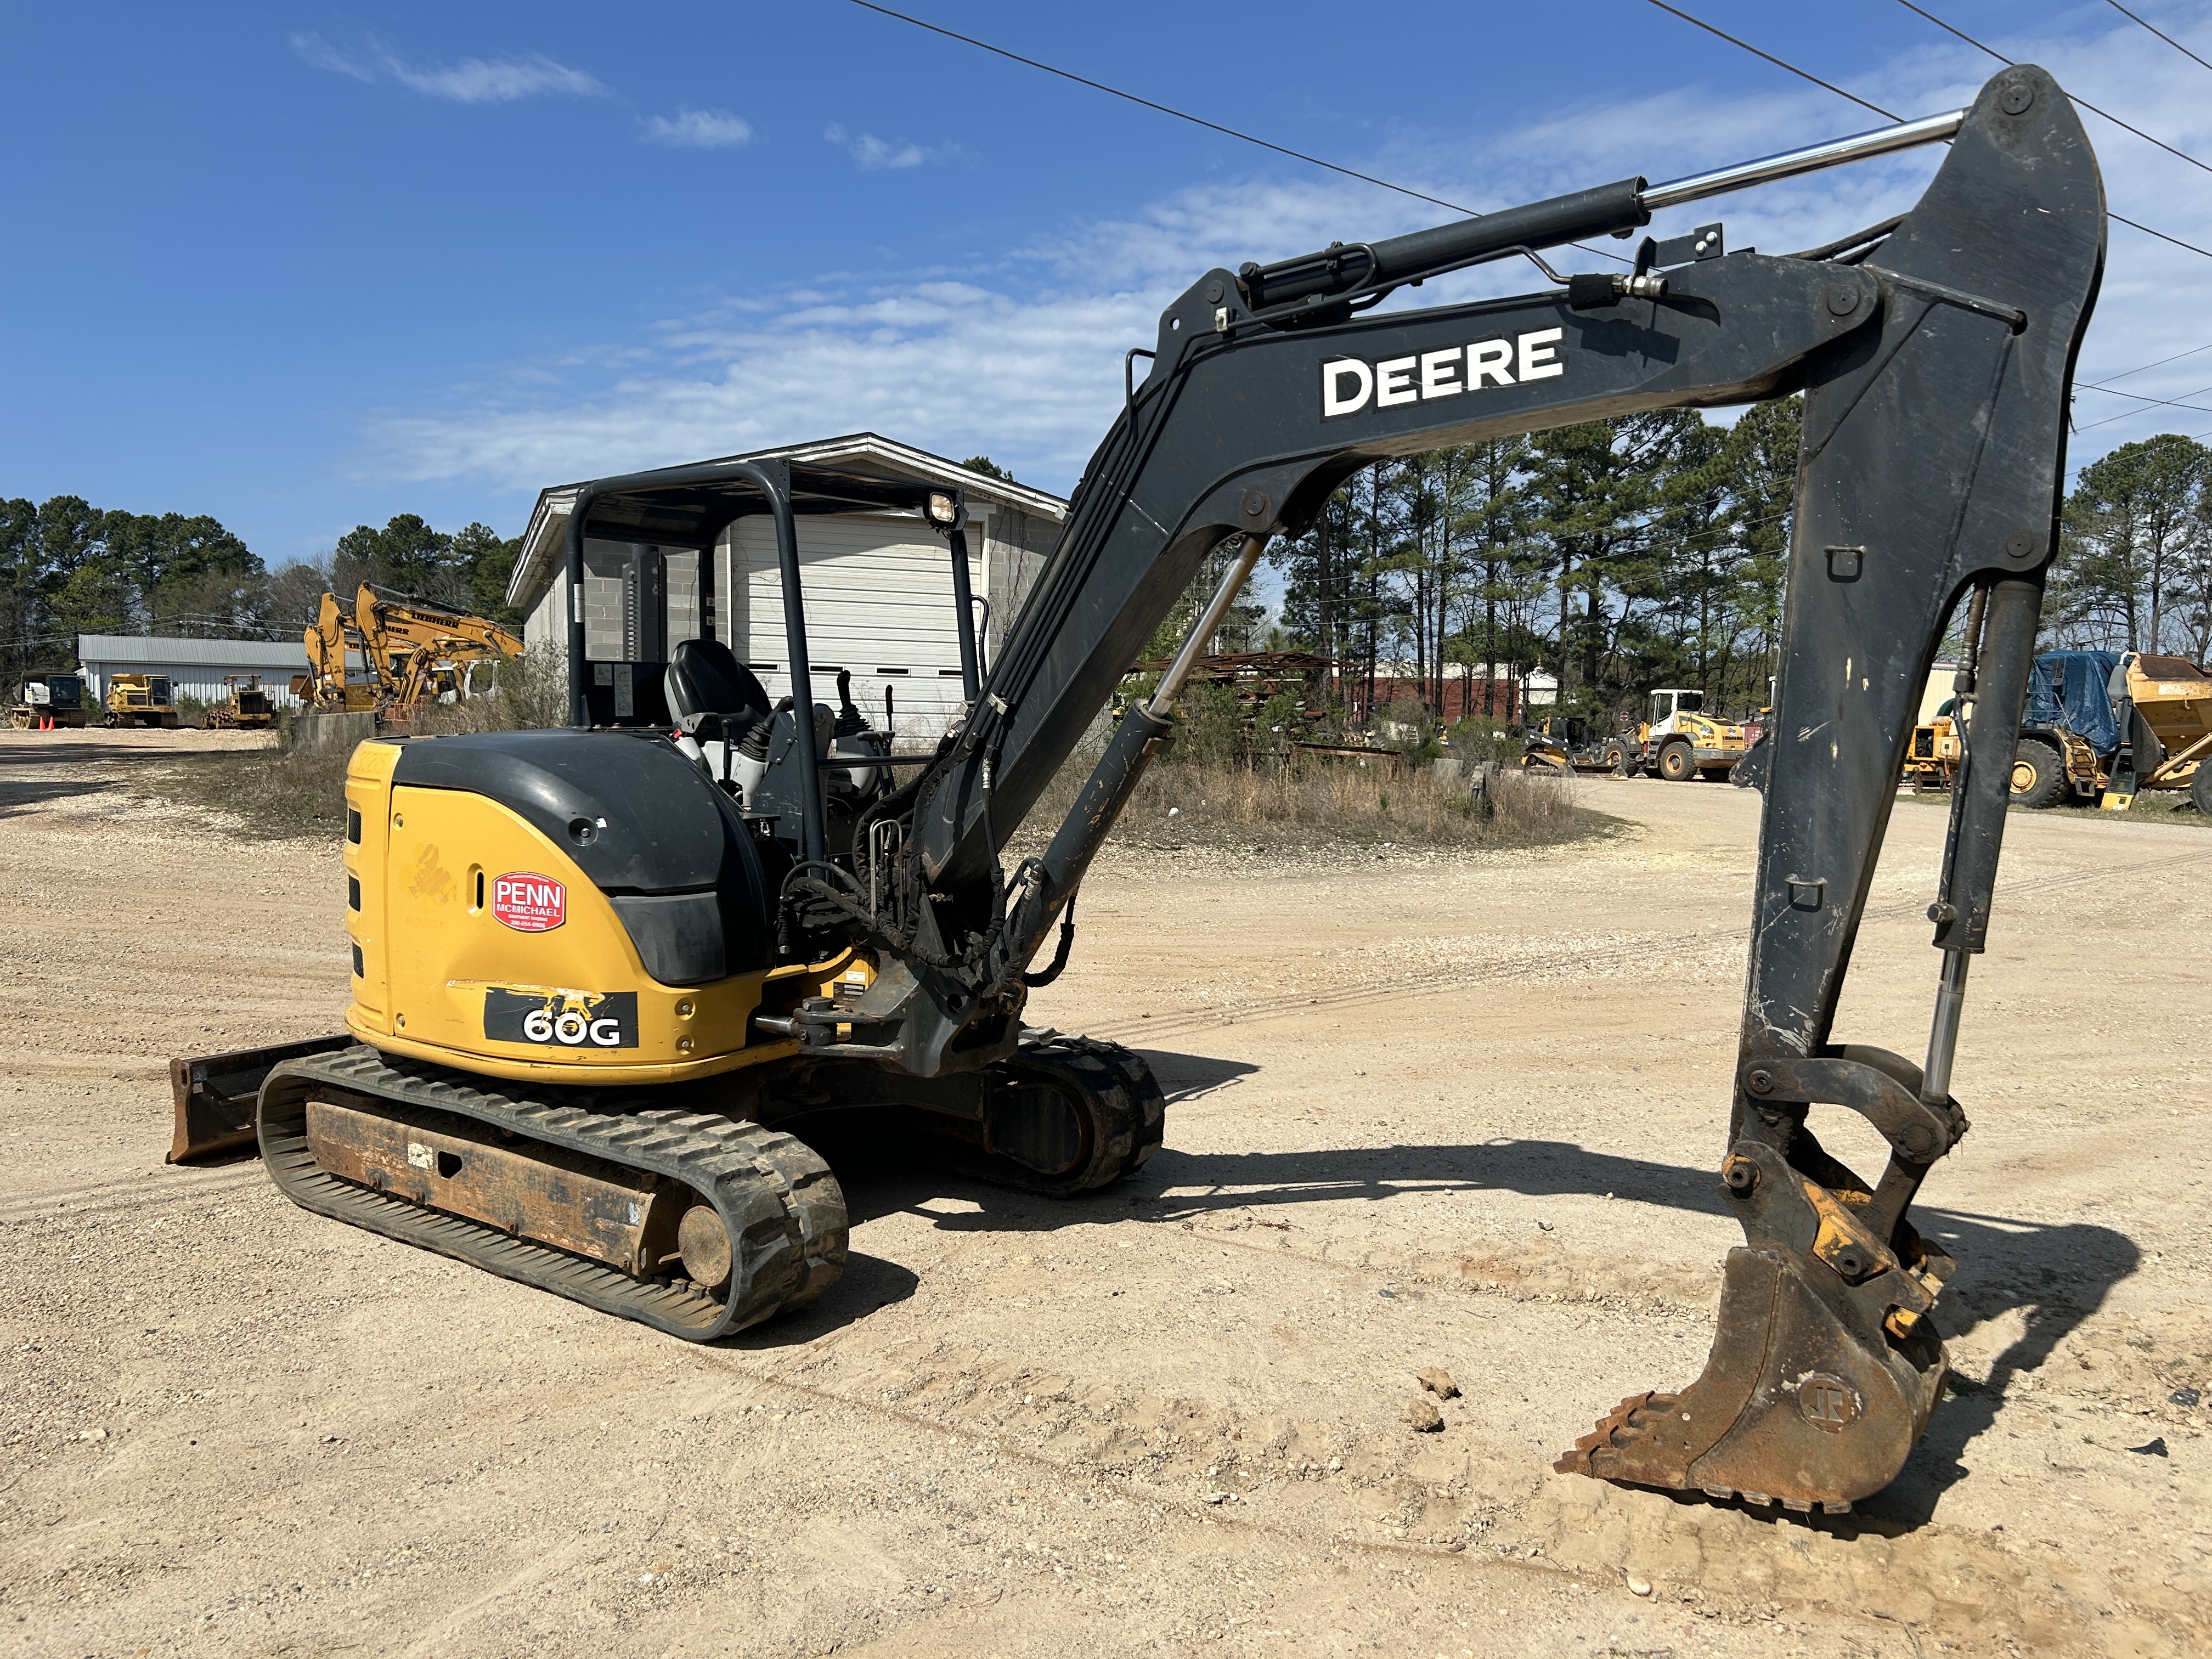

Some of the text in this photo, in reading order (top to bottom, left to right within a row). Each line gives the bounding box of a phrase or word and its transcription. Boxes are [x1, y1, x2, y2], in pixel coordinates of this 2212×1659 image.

[1323, 326, 1563, 417] DEERE
[386, 624, 409, 635] HERR
[411, 612, 459, 629] LIEBHERR
[496, 881, 561, 908] PENN
[496, 904, 561, 917] MCMICHAEL
[523, 1009, 620, 1046] 60G
